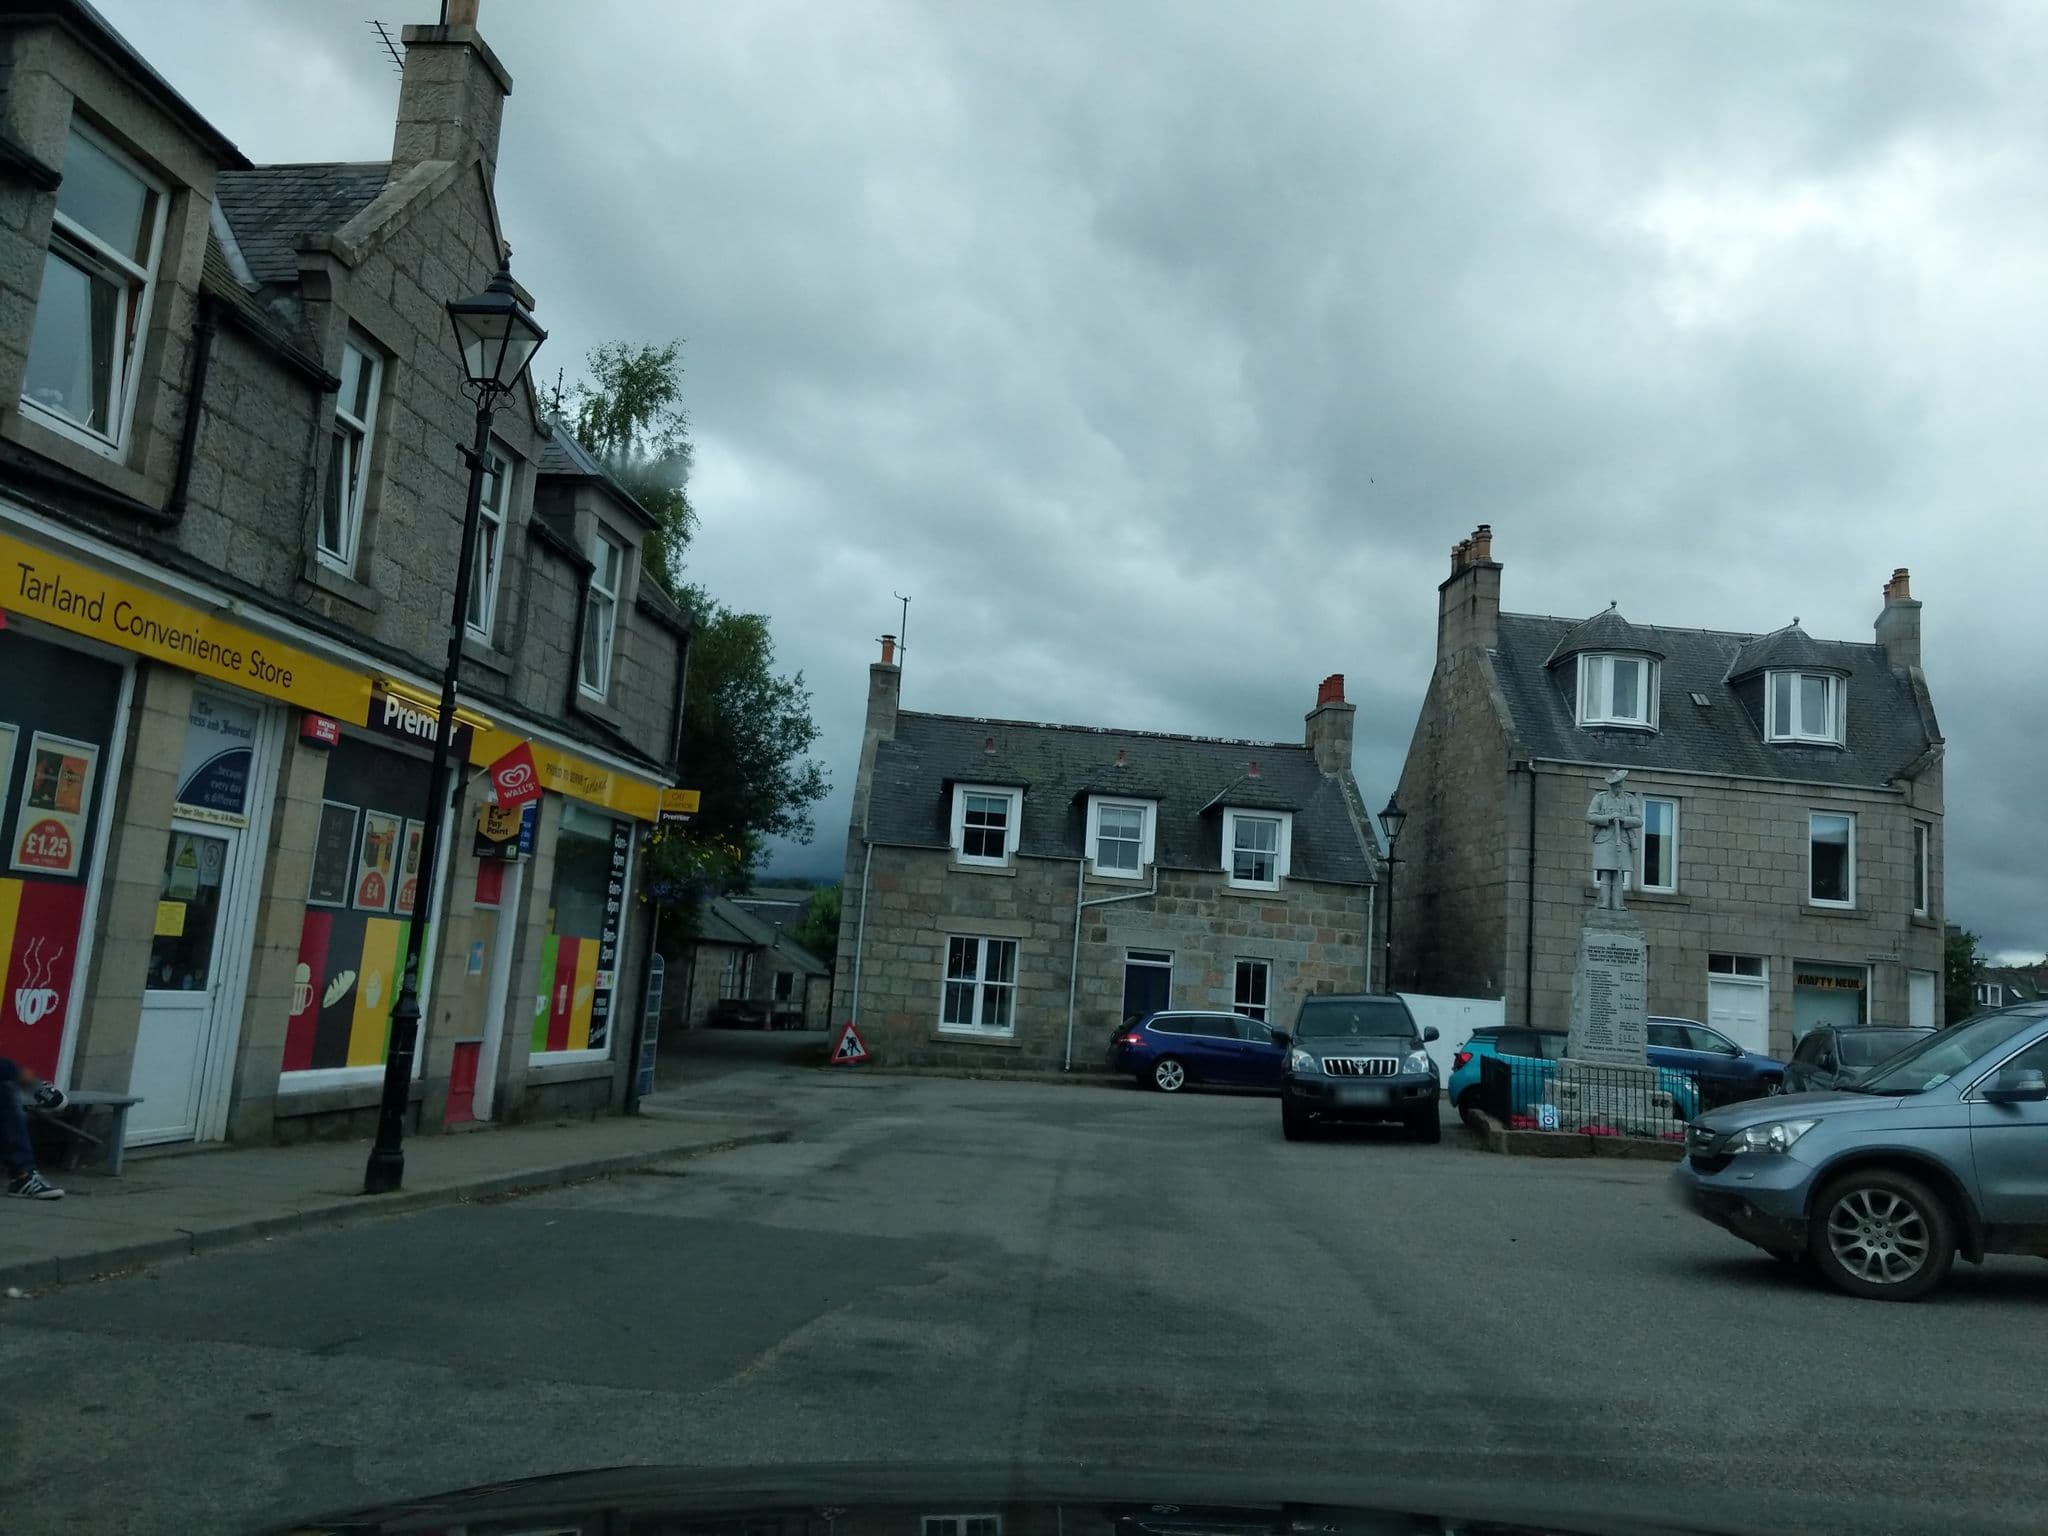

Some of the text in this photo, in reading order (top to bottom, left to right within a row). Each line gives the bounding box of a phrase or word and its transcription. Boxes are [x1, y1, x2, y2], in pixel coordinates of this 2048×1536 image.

[17, 562, 293, 689] Tarland Convenience Store
[383, 694, 459, 747] Premir
[503, 782, 536, 799] WALL'S
[487, 827, 508, 835] Point
[488, 819, 503, 829] Pay
[25, 831, 69, 858] £1.25
